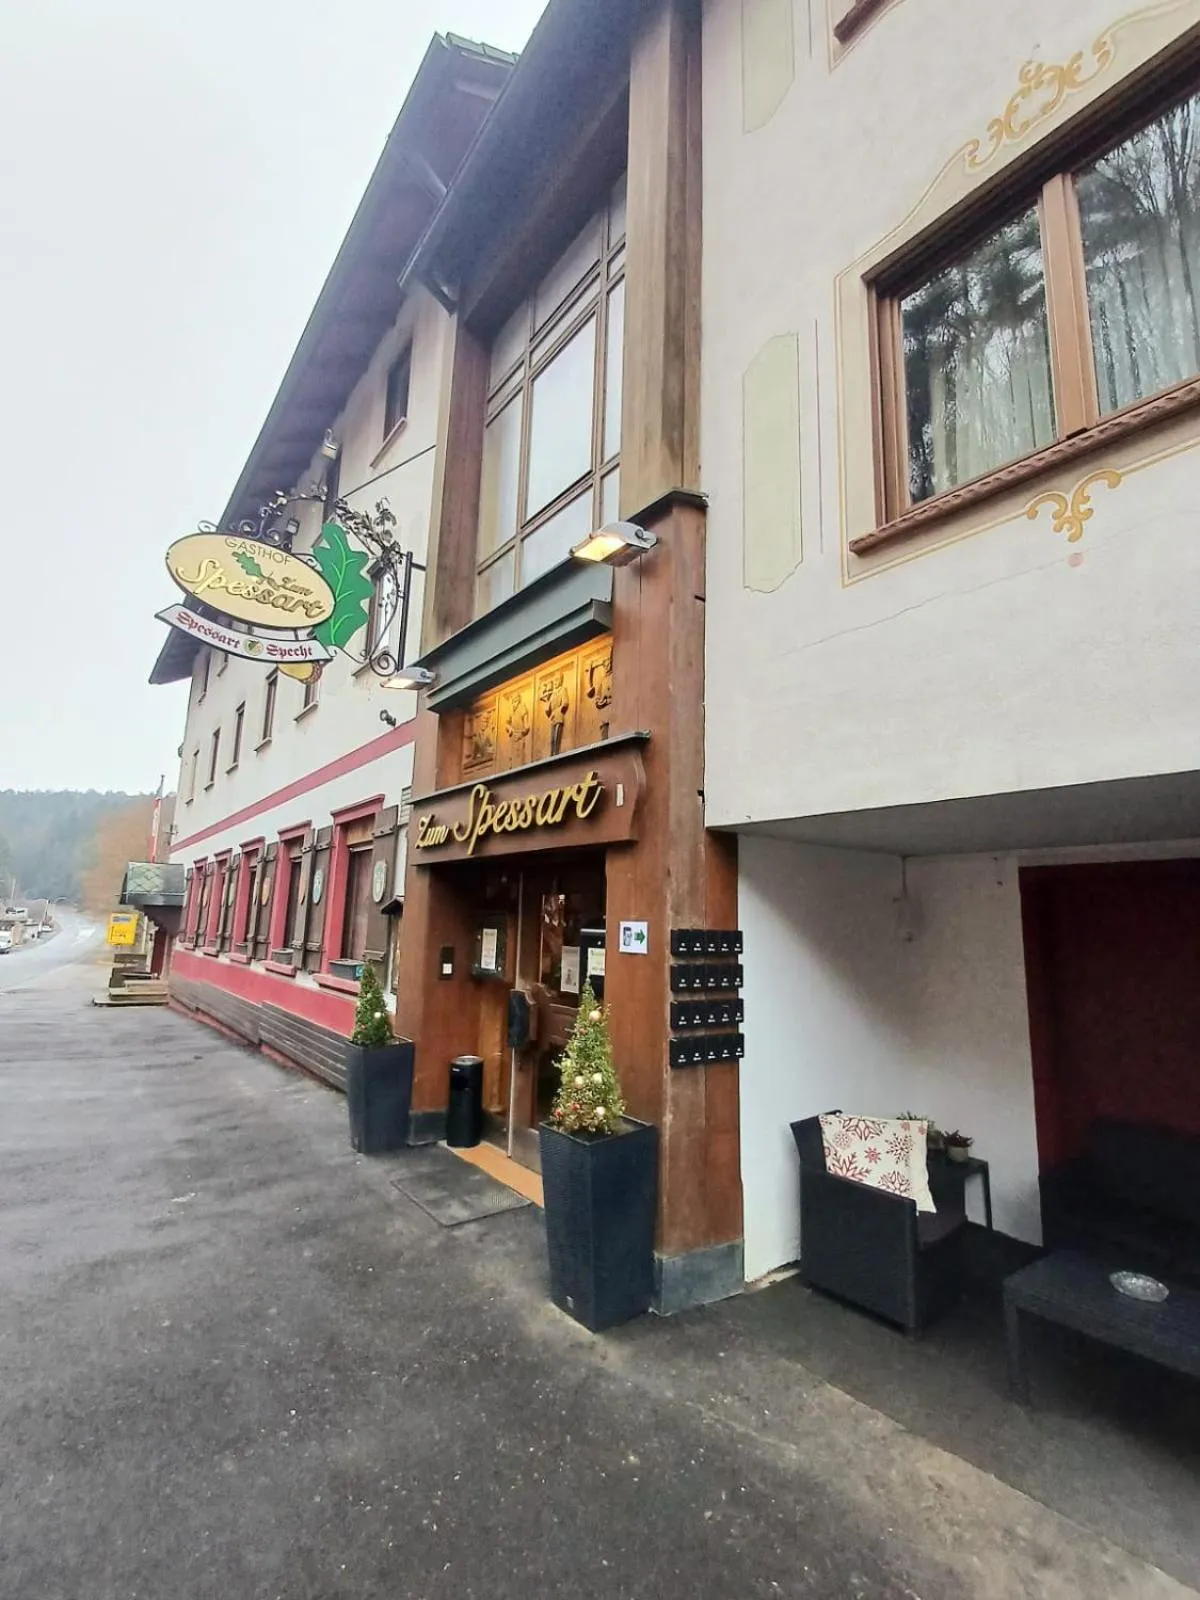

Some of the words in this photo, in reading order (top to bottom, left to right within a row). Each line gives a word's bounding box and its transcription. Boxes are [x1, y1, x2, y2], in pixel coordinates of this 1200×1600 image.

[225, 537, 292, 565] GASTHOF
[176, 558, 326, 618] Spessart
[176, 611, 240, 649] Spessart
[266, 644, 313, 659] Specht
[414, 813, 449, 849] Zum
[453, 771, 606, 856] Spessart
